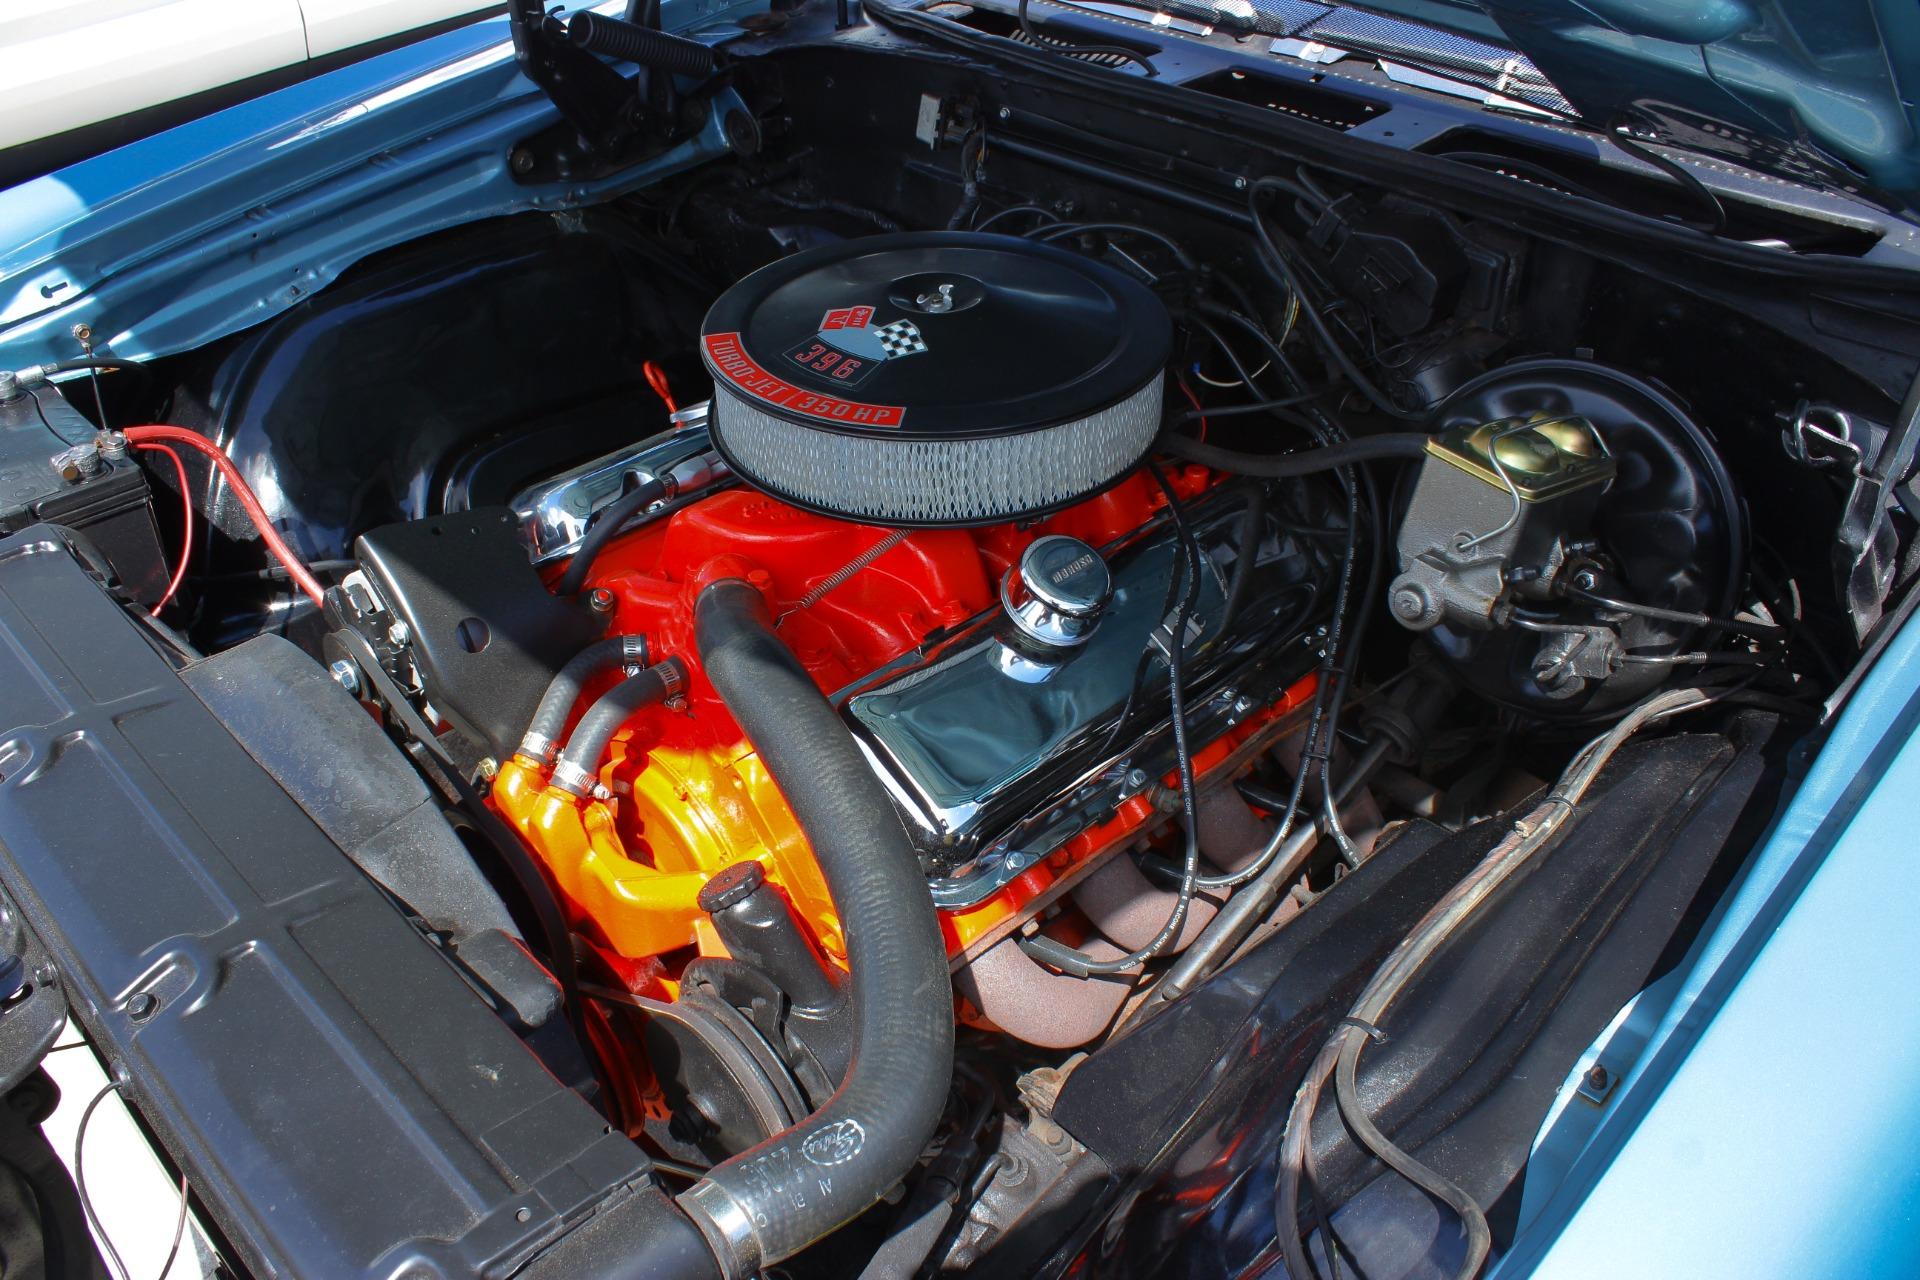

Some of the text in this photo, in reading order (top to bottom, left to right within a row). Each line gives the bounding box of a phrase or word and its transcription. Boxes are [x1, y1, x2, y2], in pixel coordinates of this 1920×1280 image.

[795, 344, 862, 379] 396
[711, 339, 891, 422] TURBO-JET 350 HP
[1153, 932, 1169, 951] JACKET
